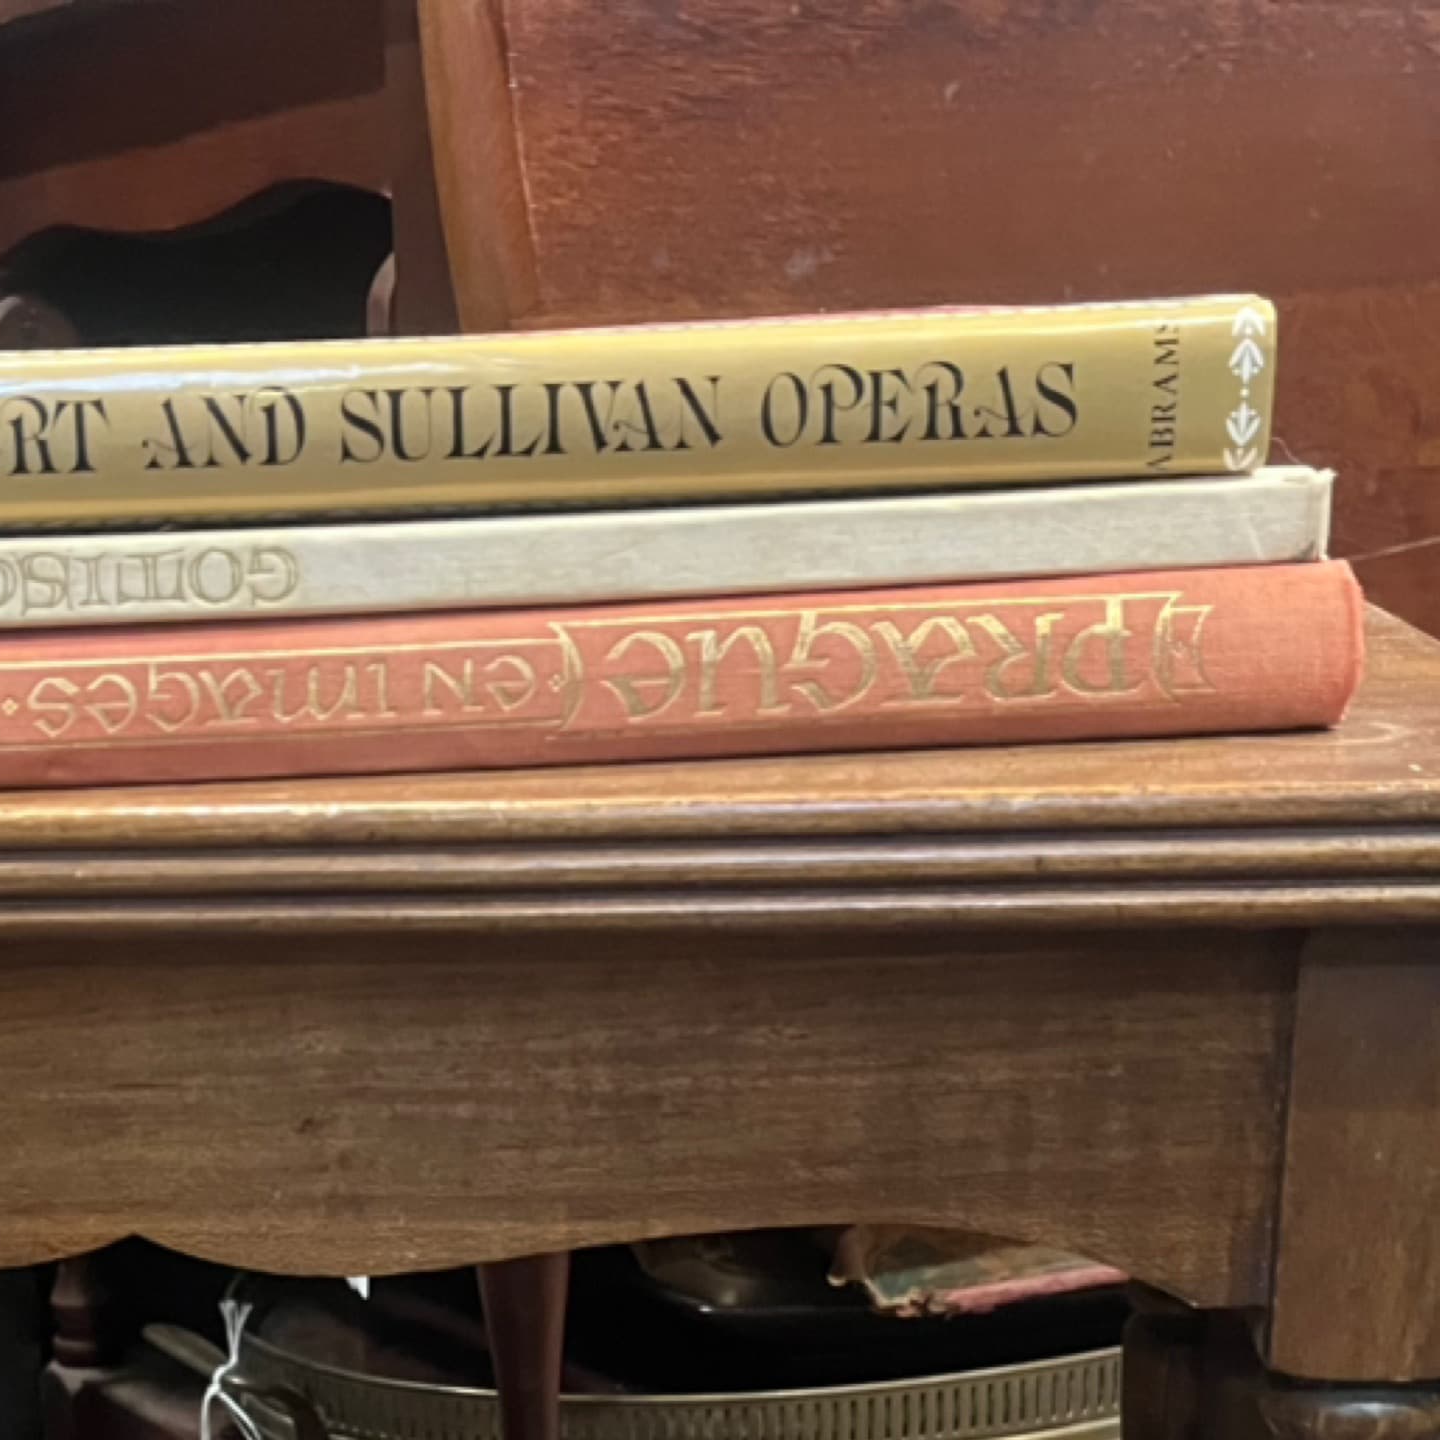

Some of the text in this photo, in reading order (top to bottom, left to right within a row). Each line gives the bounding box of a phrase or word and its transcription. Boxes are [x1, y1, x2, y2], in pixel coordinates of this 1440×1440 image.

[143, 384, 308, 472] AND
[339, 374, 725, 464] SULLIVAN
[760, 360, 1078, 450] OPERAS
[1146, 323, 1180, 473] ABRAMS
